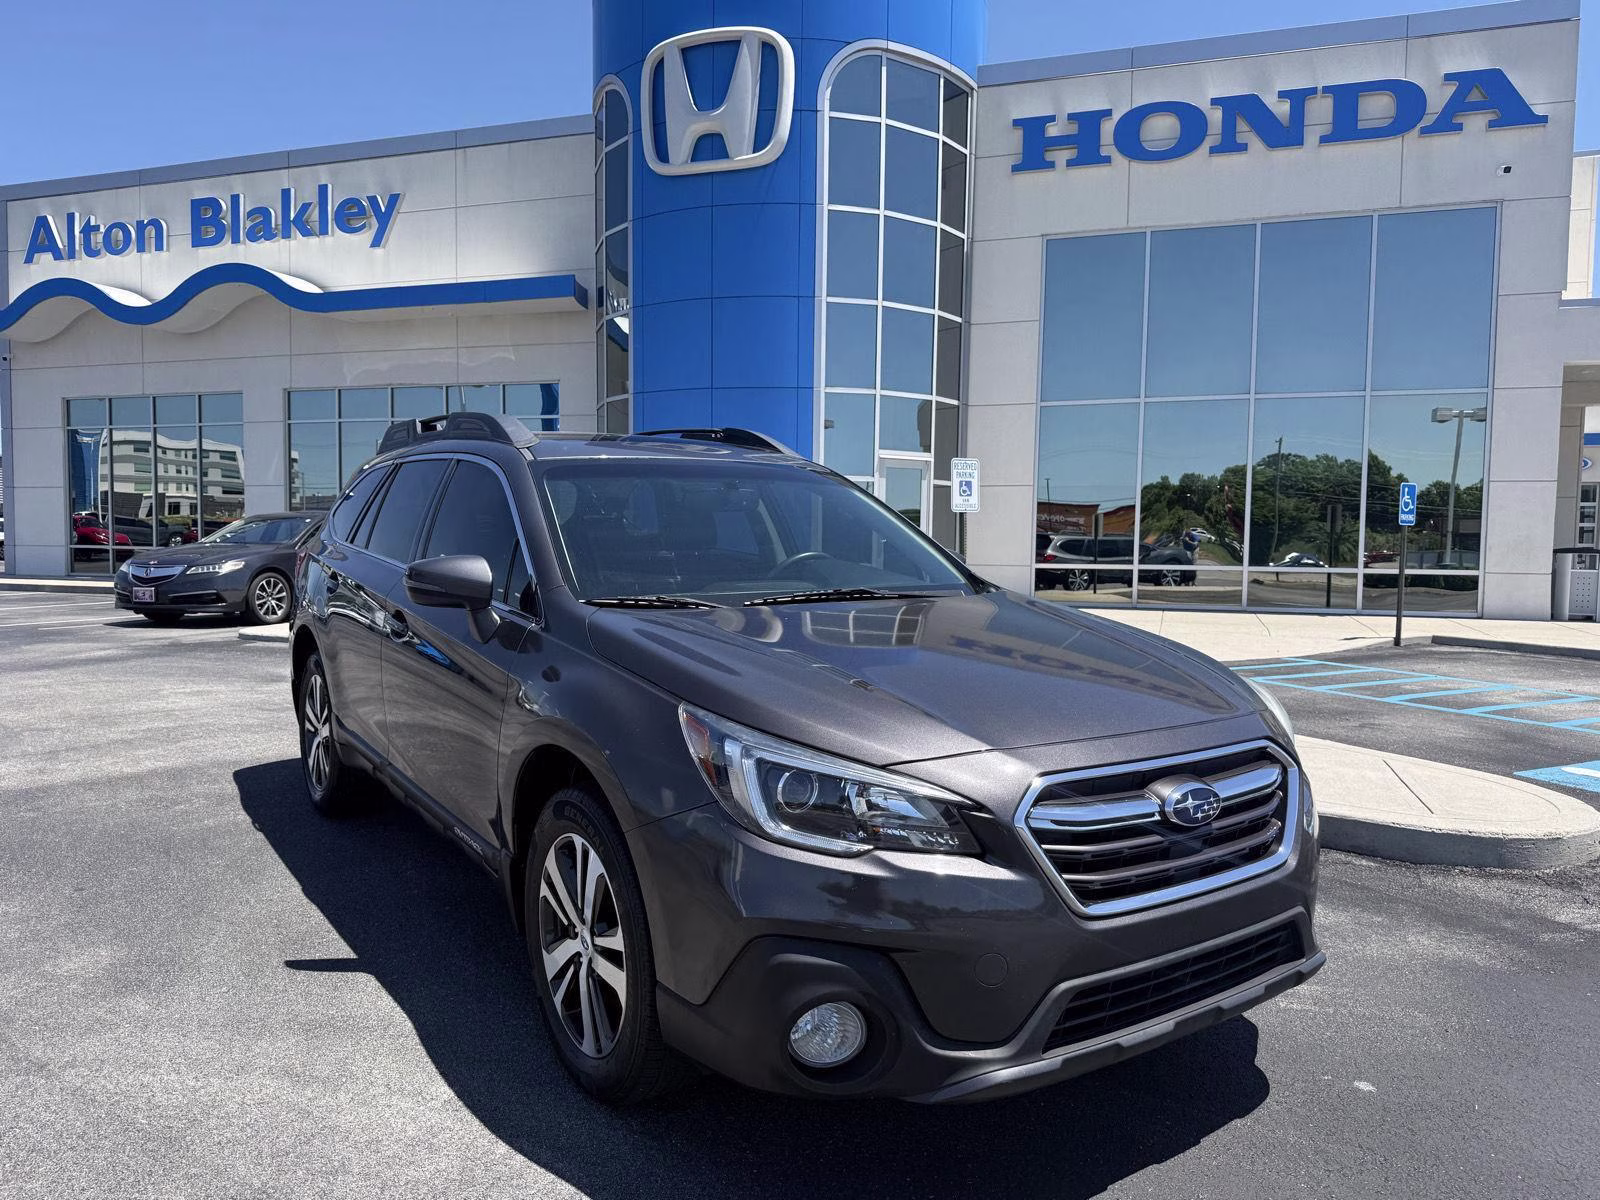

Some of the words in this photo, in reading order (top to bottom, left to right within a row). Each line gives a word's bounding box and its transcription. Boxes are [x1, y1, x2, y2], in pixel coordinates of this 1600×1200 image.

[1011, 67, 1549, 173] HONDA
[23, 211, 168, 265] Alton
[190, 183, 403, 249] Blakley
[954, 462, 976, 470] RESERVED
